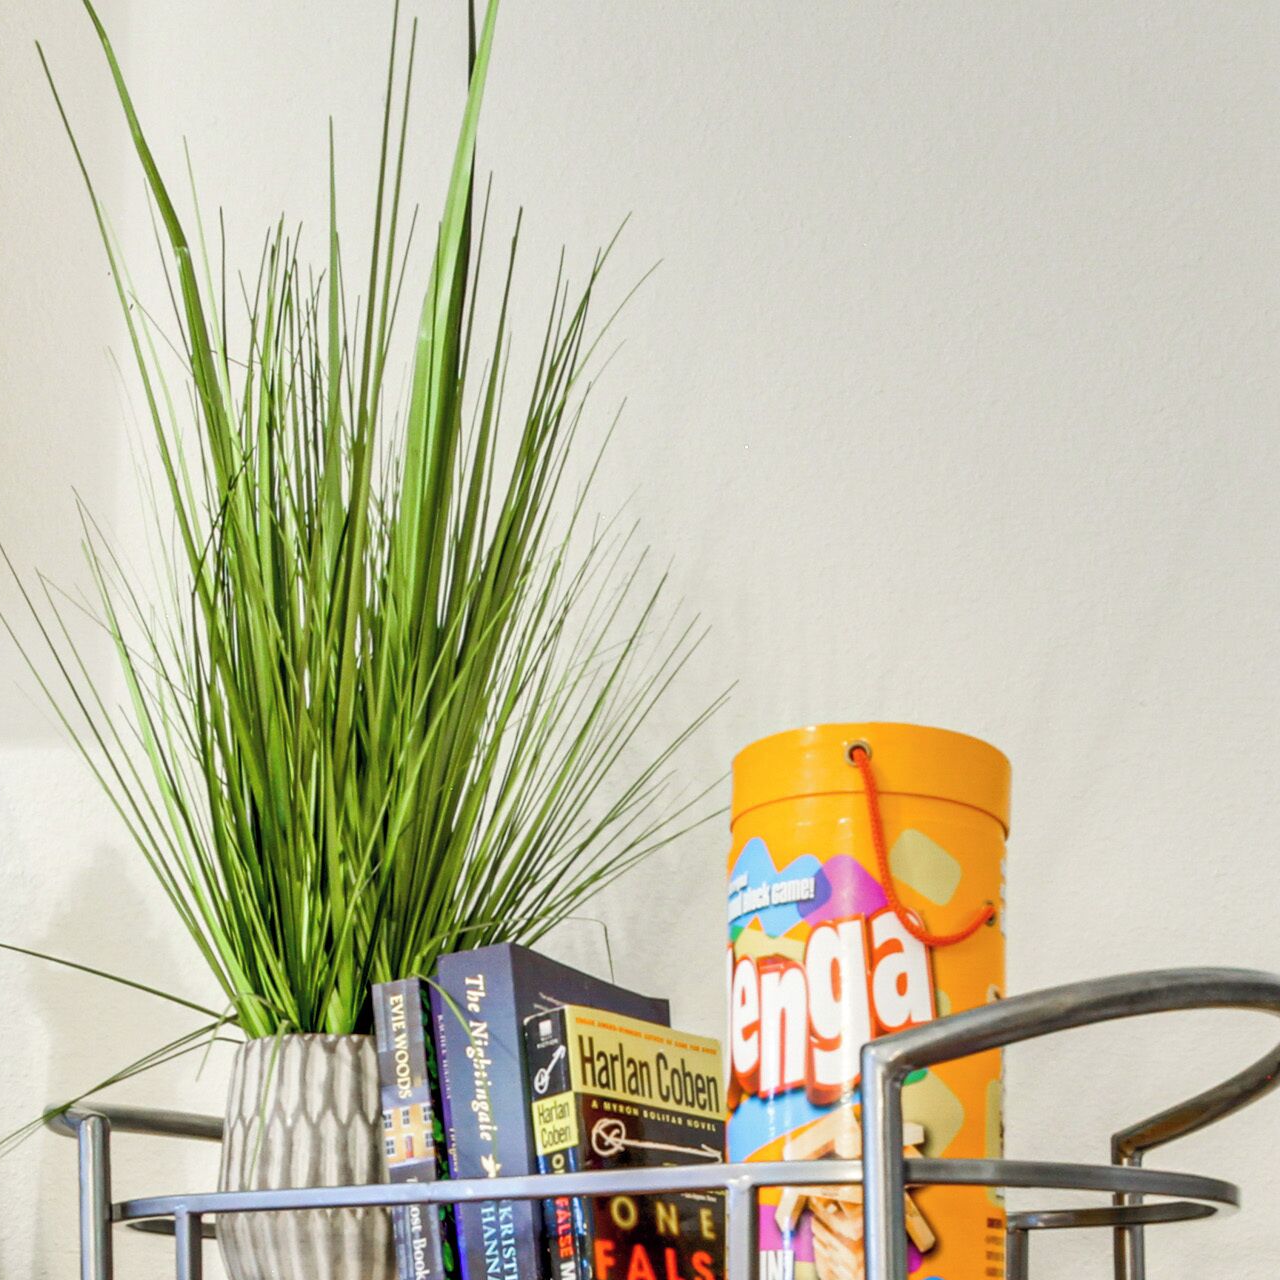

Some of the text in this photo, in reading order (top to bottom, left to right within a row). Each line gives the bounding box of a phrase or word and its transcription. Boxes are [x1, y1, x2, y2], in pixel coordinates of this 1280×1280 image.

[771, 877, 815, 903] game!
[465, 974, 486, 1013] The
[726, 906, 936, 1094] enga
[389, 994, 412, 1099] EVIE WOODS
[578, 1034, 720, 1113] Harlan Coben
[538, 1100, 569, 1125] Harlan
[591, 1100, 717, 1132] A MYRON BOLITAR NOVEL
[541, 1124, 571, 1148] Coben
[408, 1204, 423, 1232] ost
[555, 1197, 574, 1258] FALSE
[611, 1195, 716, 1241] ONE
